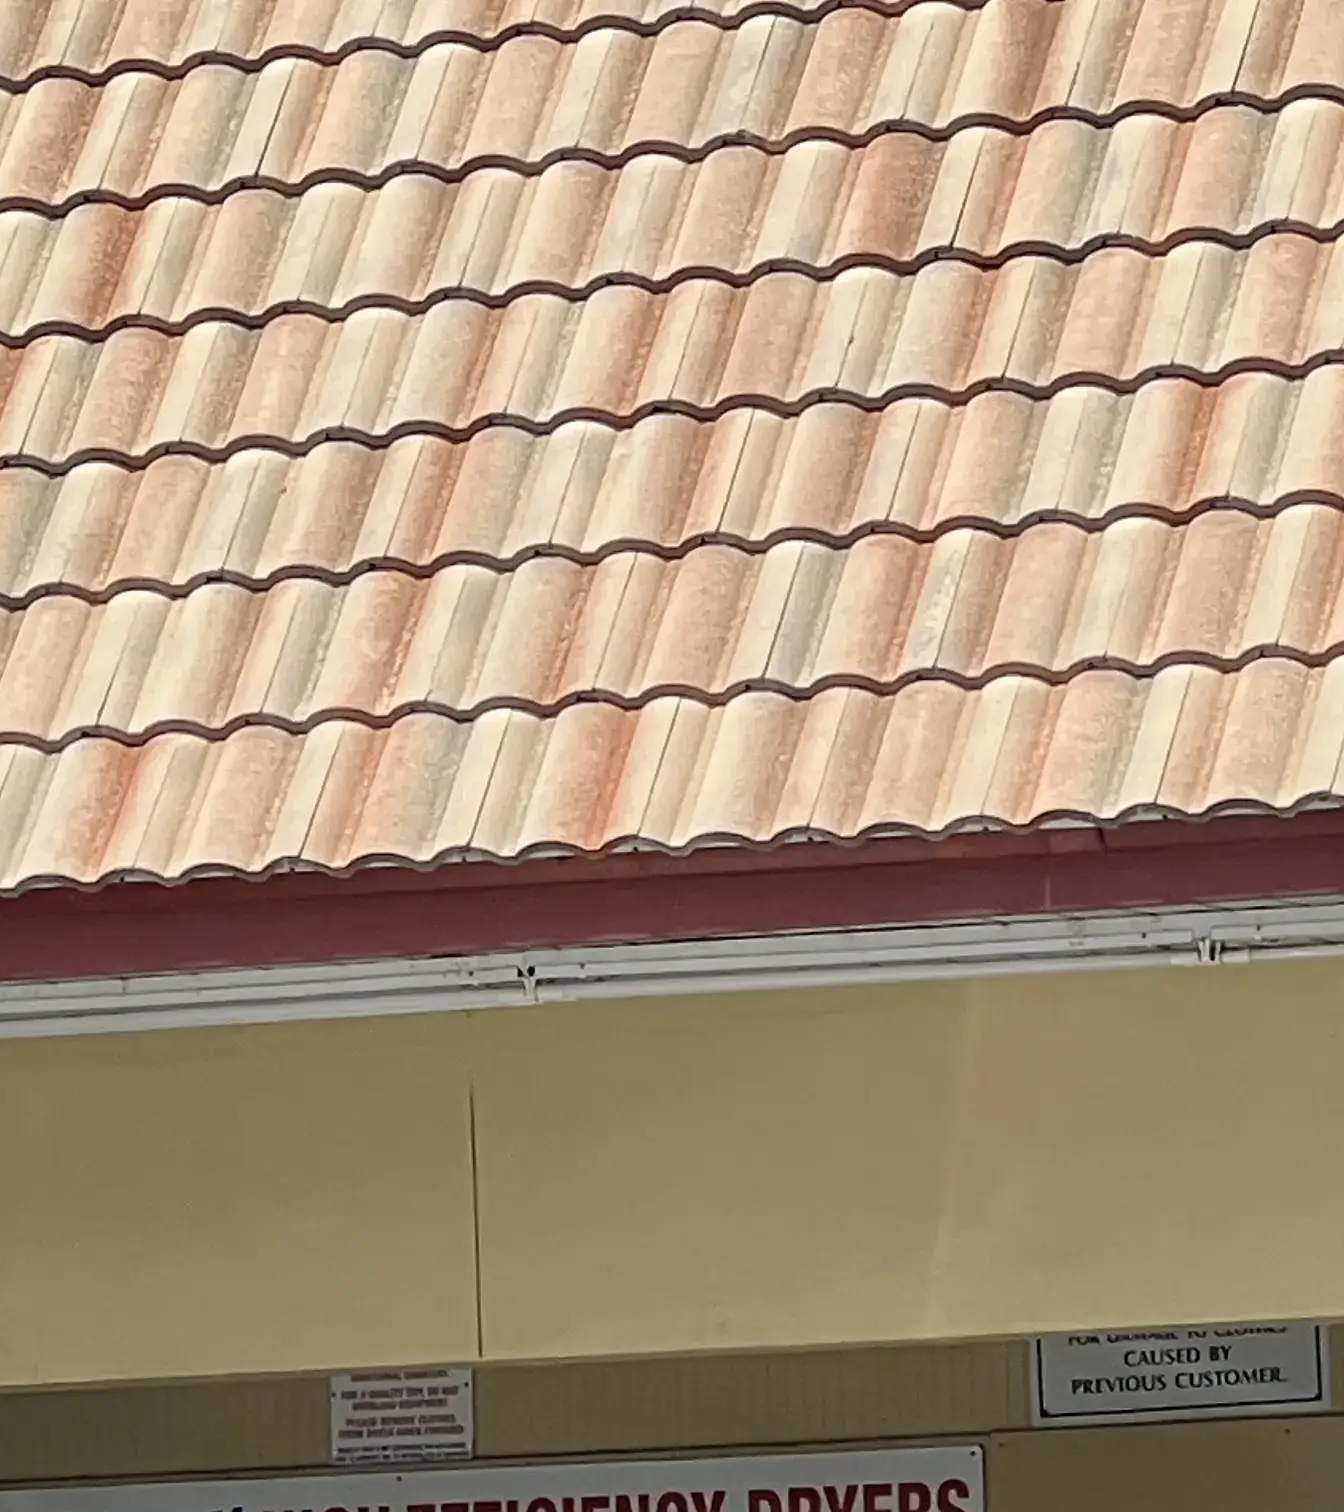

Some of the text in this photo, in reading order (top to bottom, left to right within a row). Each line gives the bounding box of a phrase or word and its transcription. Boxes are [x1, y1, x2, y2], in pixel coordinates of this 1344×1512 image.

[1124, 1345, 1231, 1368] CAUSED BY
[1071, 1373, 1167, 1395] PREVIOUS
